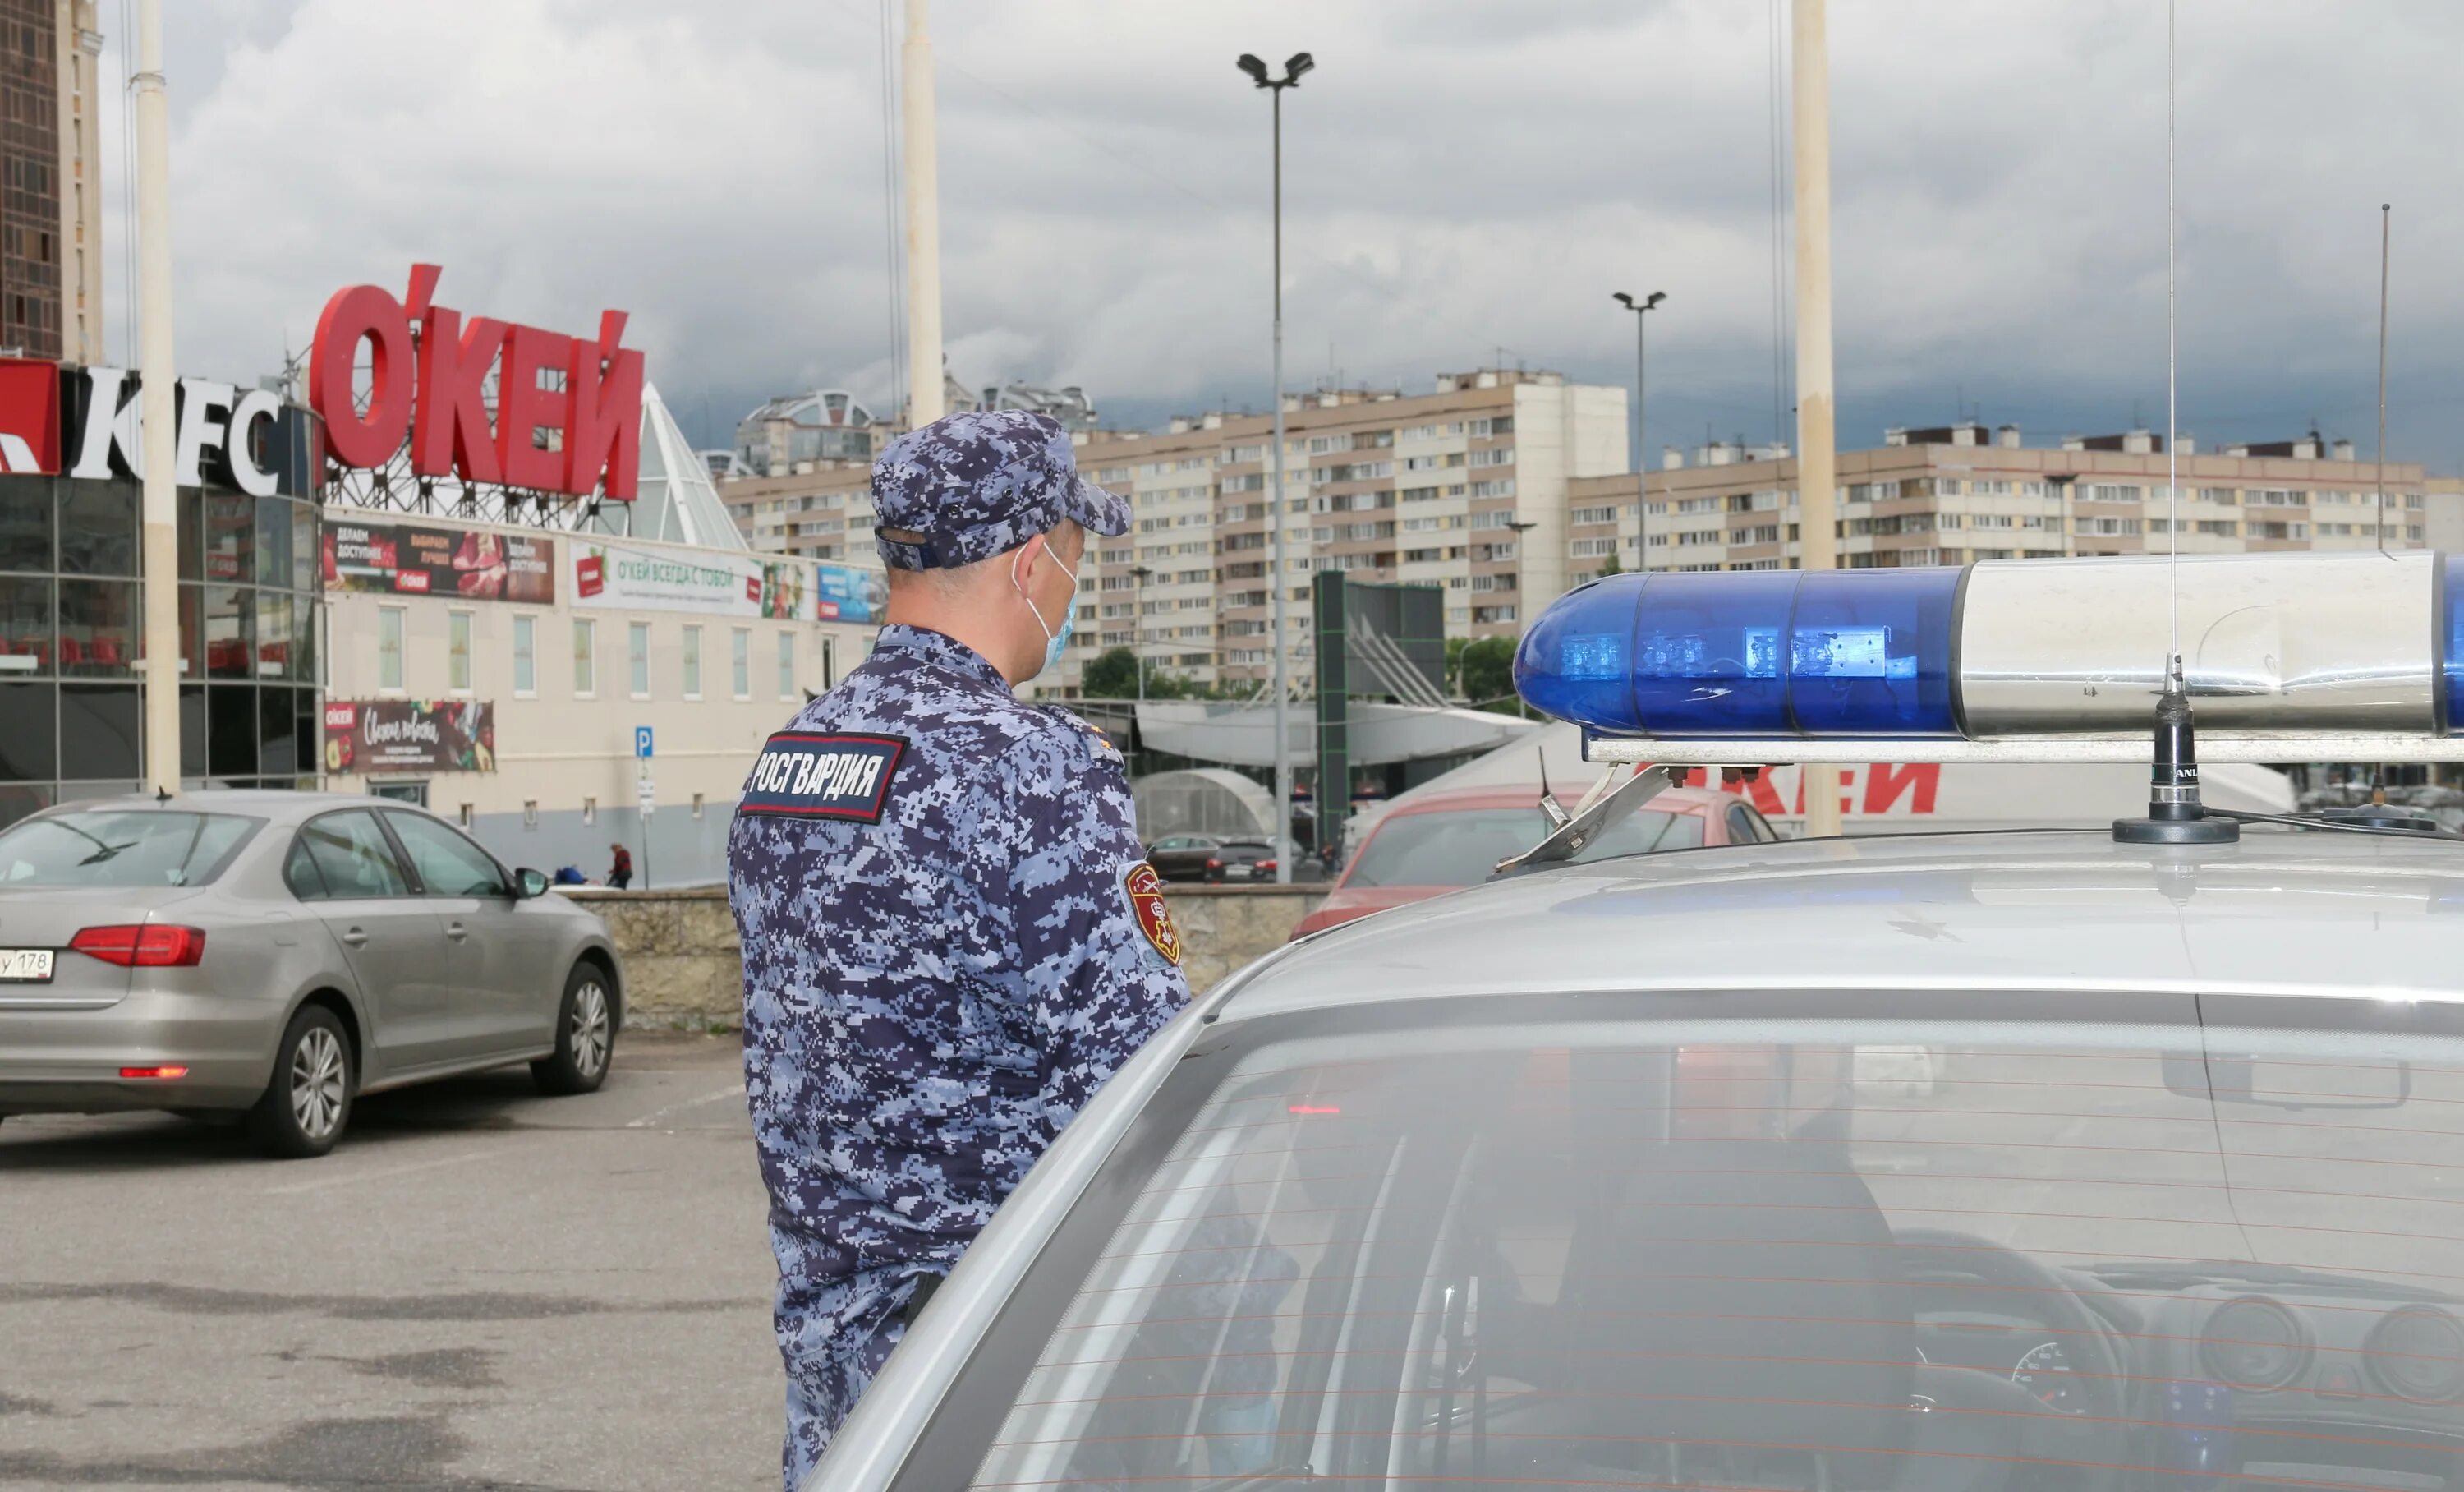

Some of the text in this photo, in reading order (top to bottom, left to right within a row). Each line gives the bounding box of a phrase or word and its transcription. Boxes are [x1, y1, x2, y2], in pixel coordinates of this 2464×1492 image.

[71, 366, 279, 497] KFC
[652, 563, 690, 586] ВСЕГДА
[692, 566, 700, 584] С
[701, 567, 734, 587] ТОБОЙ
[638, 730, 651, 757] P
[749, 752, 885, 801] РОСГВАРДИЯ
[18, 952, 48, 969] 178
